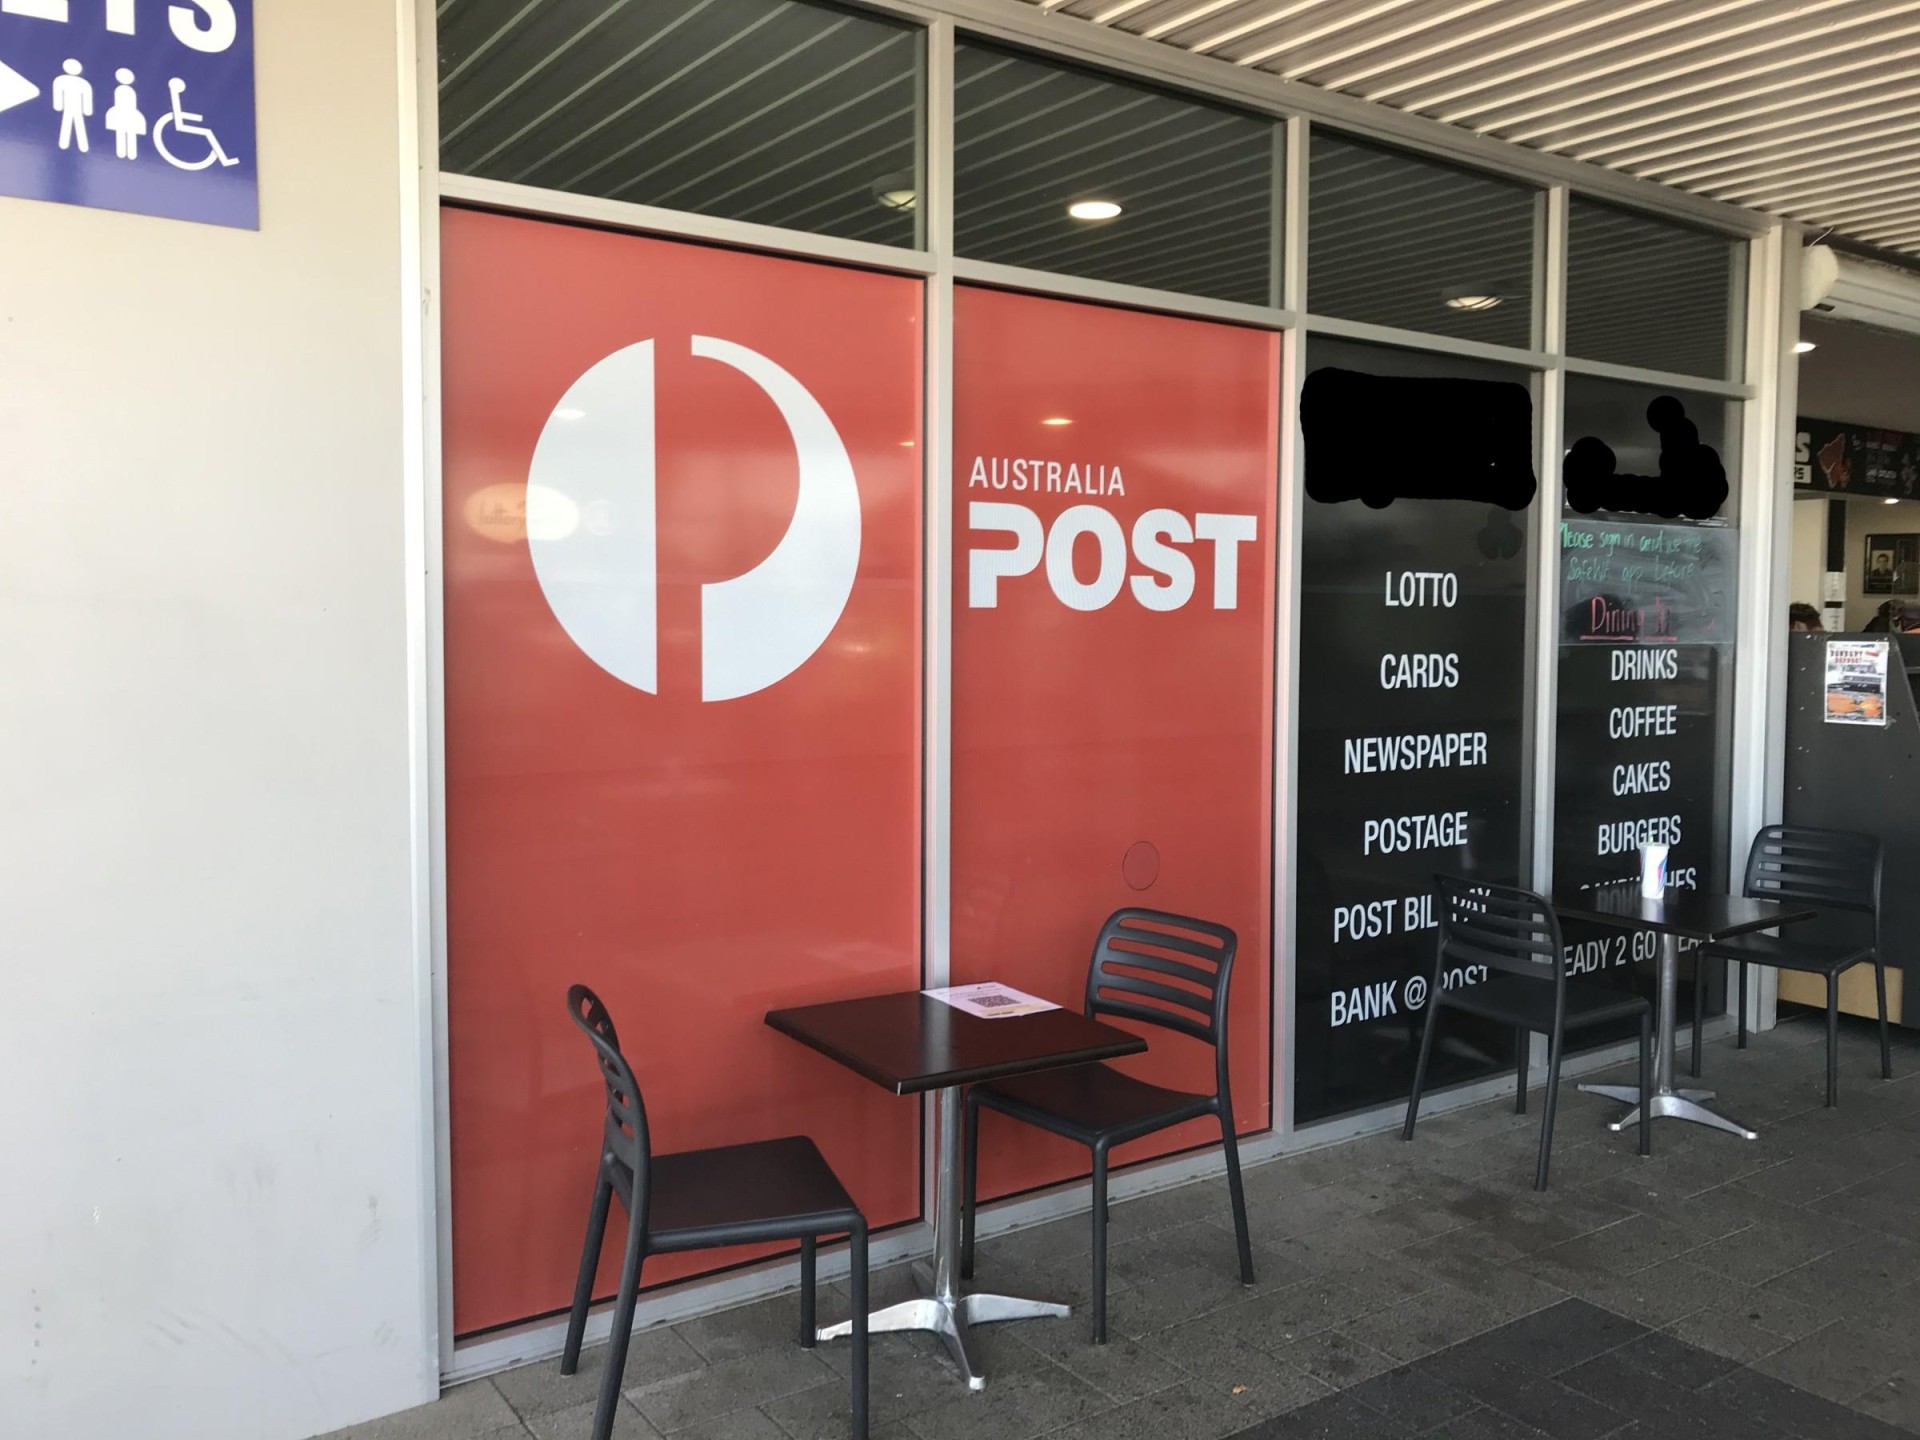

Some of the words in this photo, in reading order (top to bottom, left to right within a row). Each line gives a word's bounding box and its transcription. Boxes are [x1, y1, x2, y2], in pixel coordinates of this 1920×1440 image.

[968, 456, 1126, 497] AUSTRALIA
[968, 503, 1258, 611] POST
[1384, 571, 1458, 608] LOTTO
[1380, 652, 1459, 690] CARDS
[1611, 648, 1678, 681] DRINKS
[1608, 704, 1678, 739] COFFEE
[1344, 731, 1488, 775] NEWSPAPER
[1612, 760, 1671, 796] CAKES
[1364, 811, 1469, 856] POSTAGE
[1598, 814, 1681, 856] BURGERS
[1333, 899, 1398, 944] POST
[1563, 937, 1611, 977] EADY
[1615, 935, 1627, 966] 2
[1632, 930, 1657, 962] GO
[1330, 979, 1398, 1028] BANK
[1404, 975, 1427, 1011] @
